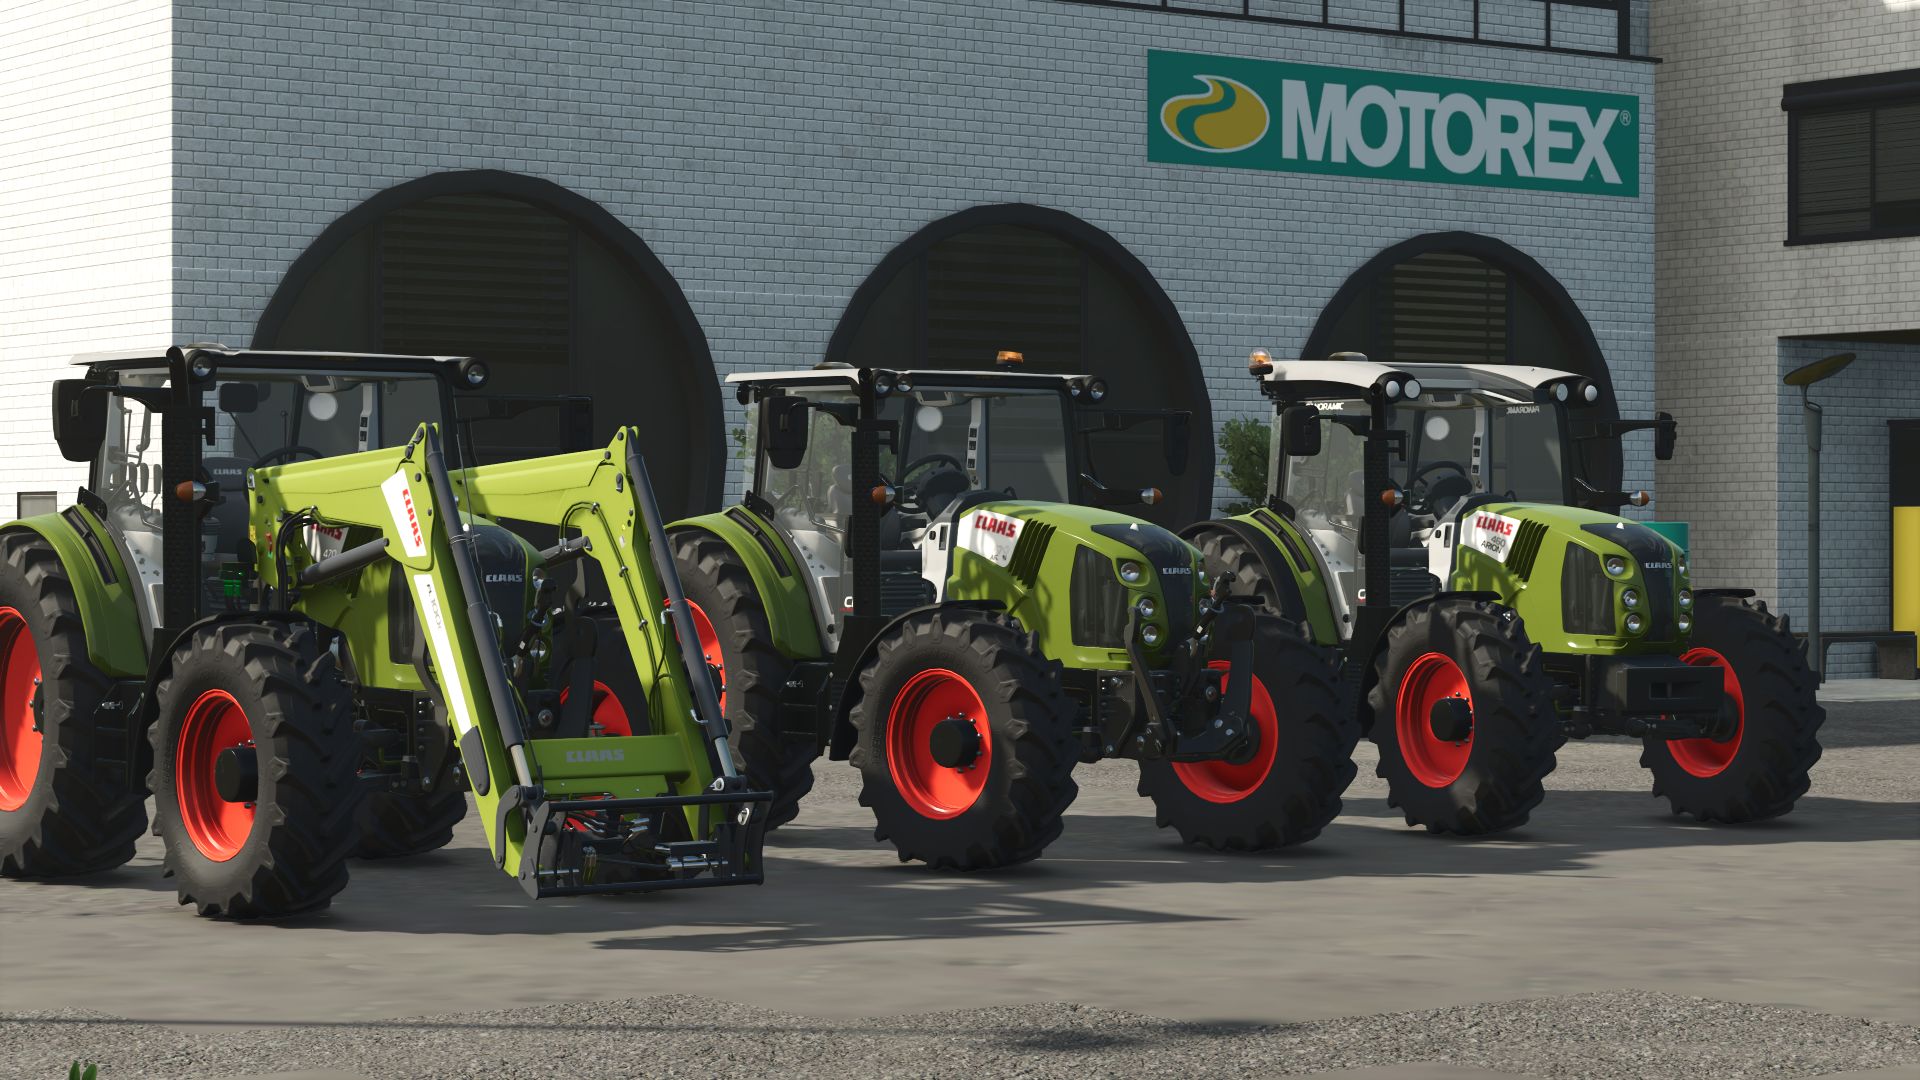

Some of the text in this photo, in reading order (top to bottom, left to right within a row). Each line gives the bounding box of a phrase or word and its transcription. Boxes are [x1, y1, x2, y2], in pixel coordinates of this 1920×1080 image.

[402, 489, 422, 548] CLAAS
[975, 515, 1016, 538] CLAAS
[1476, 516, 1513, 536] CLAAS
[485, 574, 523, 583] CLAAS
[1162, 567, 1192, 575] CLAAS
[566, 749, 625, 763] CLAAS
